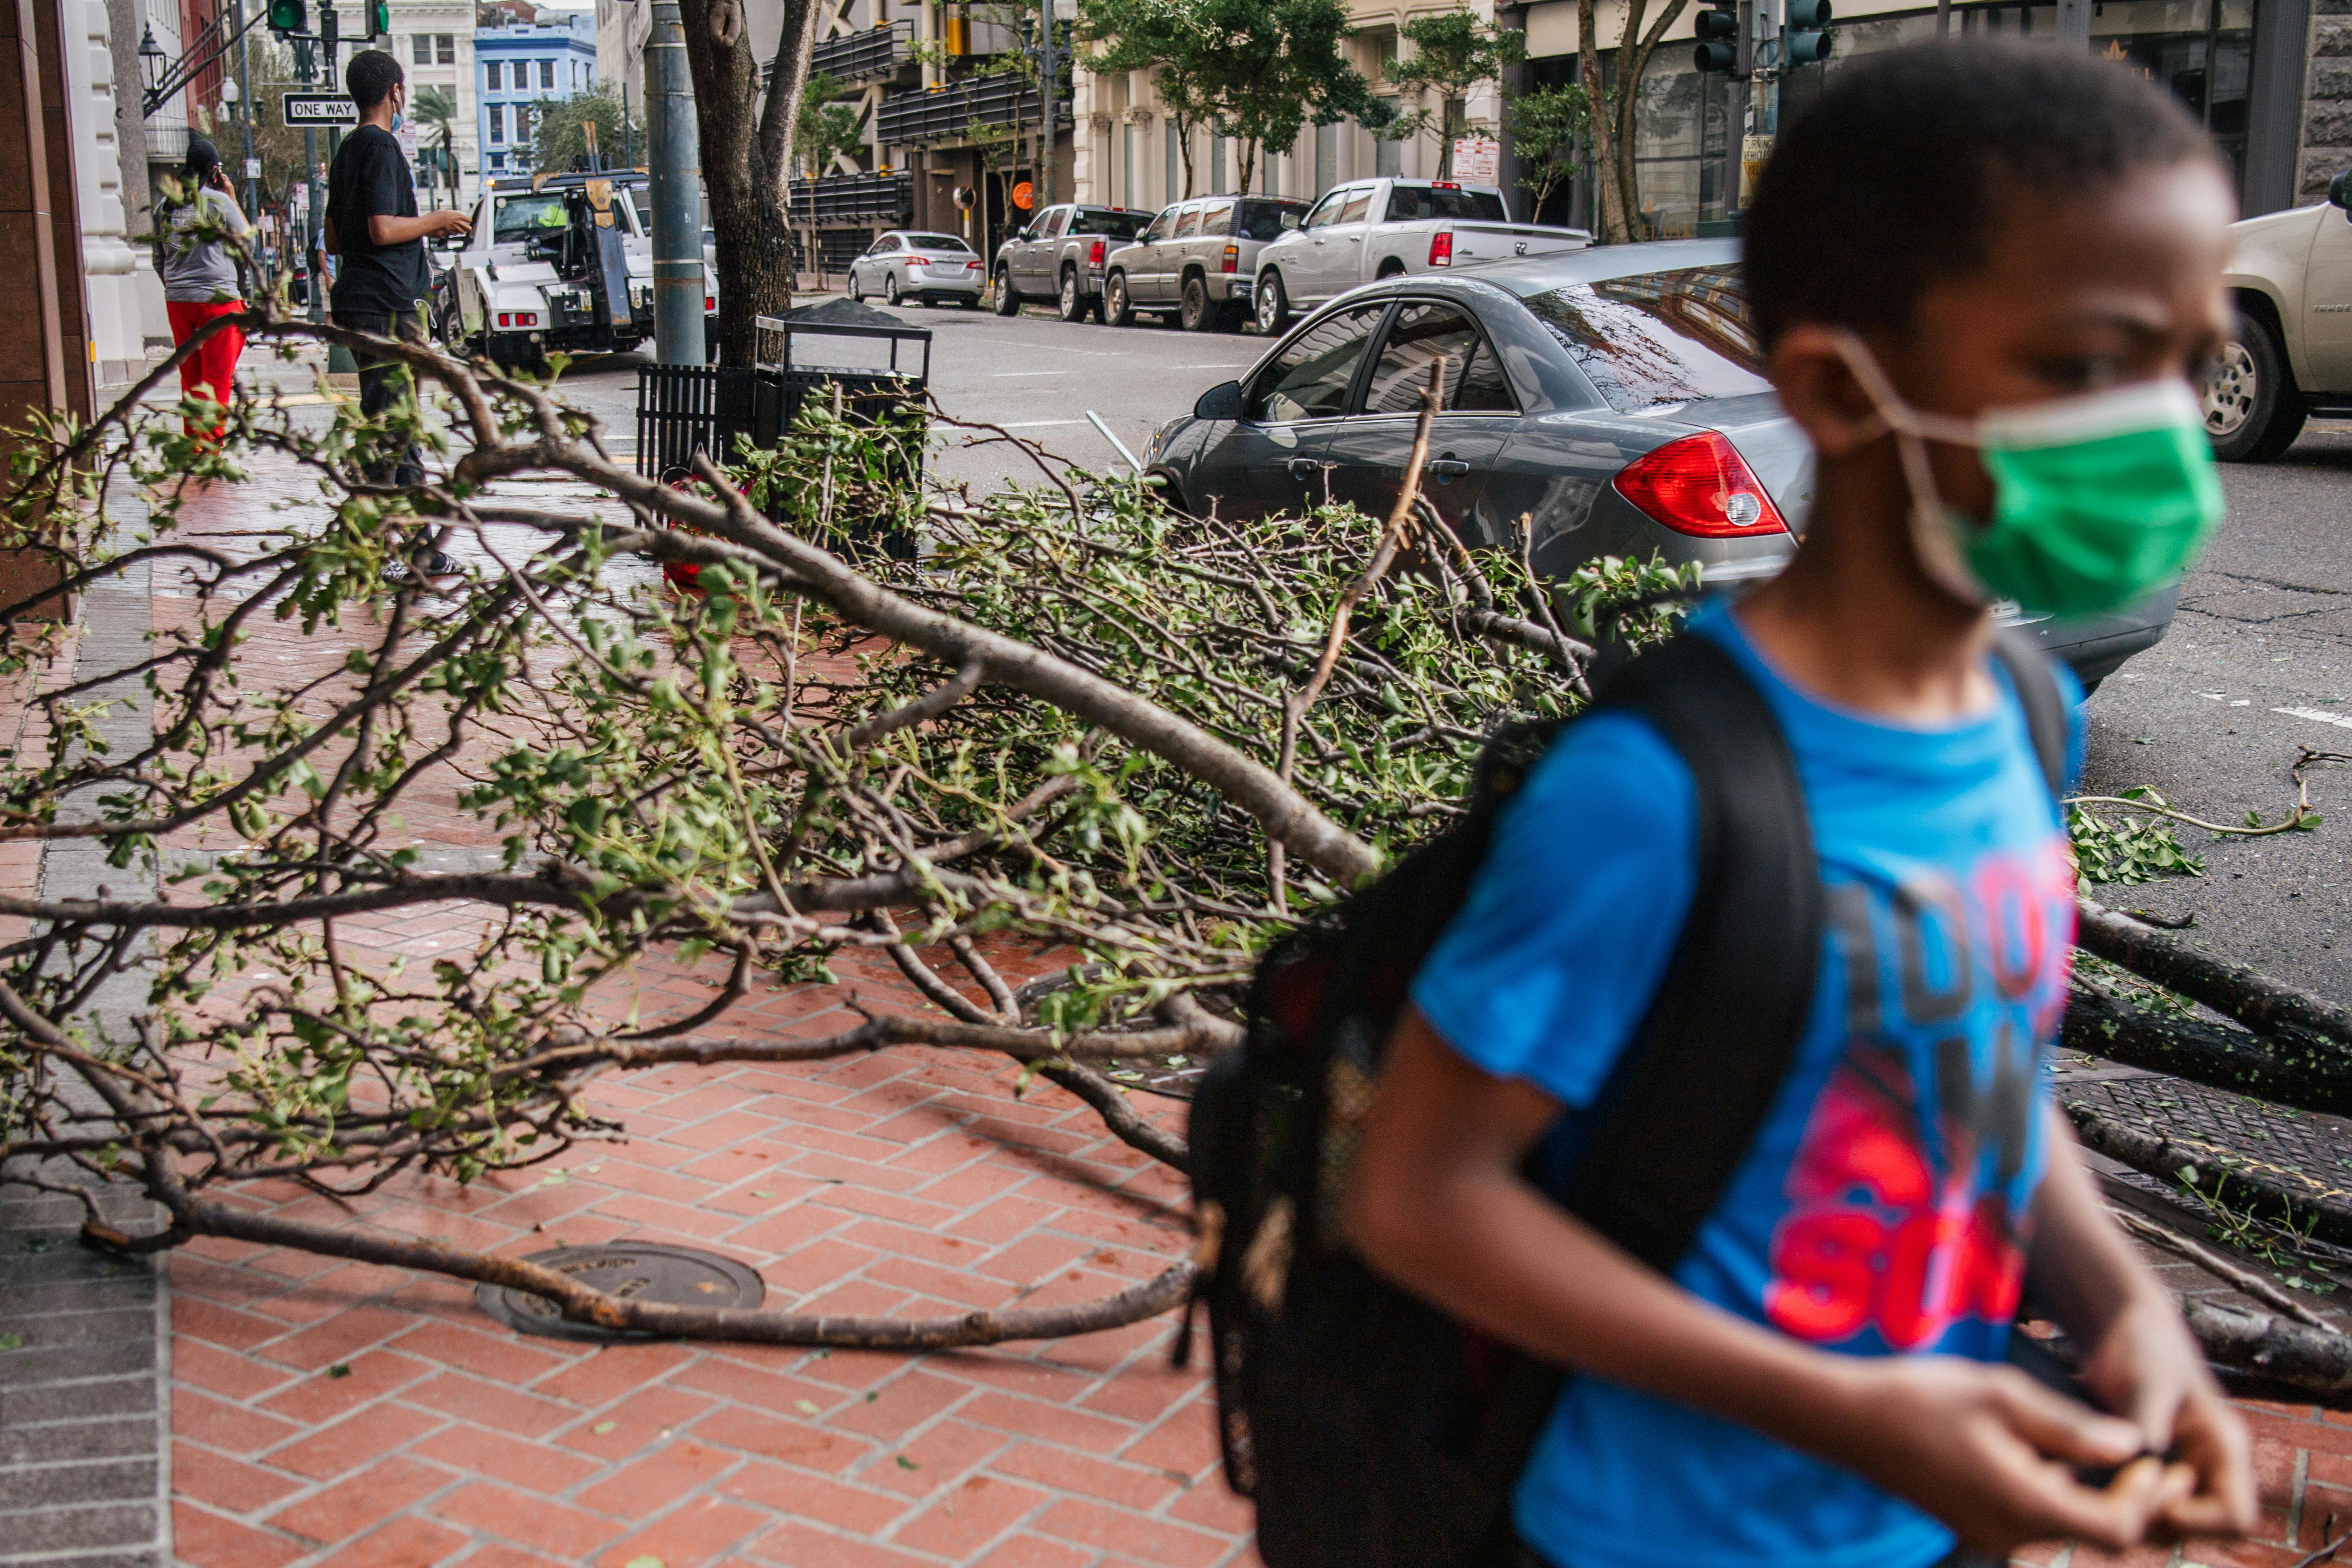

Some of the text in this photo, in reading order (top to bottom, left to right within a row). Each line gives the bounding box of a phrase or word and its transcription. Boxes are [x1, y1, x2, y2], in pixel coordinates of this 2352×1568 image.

[295, 104, 352, 115] ONE WAY
[1745, 139, 1773, 150] TURNING
[1743, 150, 1771, 161] VEHICLES
